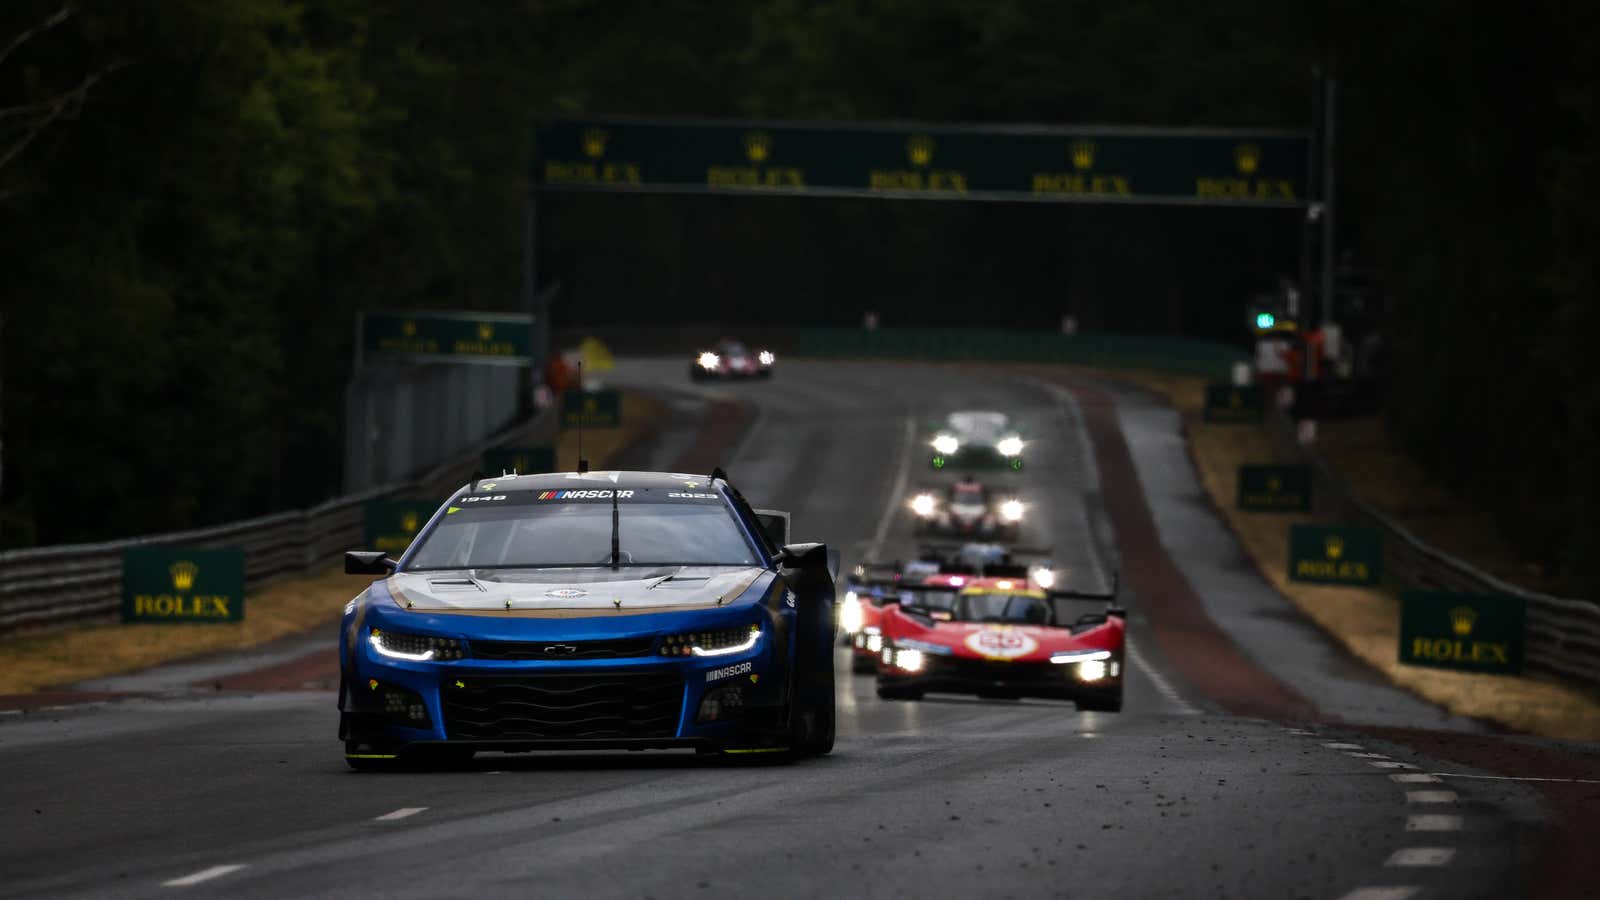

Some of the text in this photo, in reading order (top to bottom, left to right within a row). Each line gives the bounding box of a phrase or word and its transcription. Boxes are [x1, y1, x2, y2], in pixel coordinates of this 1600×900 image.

[545, 161, 641, 184] ROLEX
[707, 165, 805, 190] ROLEX
[870, 170, 968, 193] ROLEX
[1032, 173, 1131, 196] ROLEX
[1196, 176, 1295, 198] ROLEX
[460, 495, 507, 503] 1948
[561, 489, 635, 500] NASCAR
[1296, 560, 1369, 580] ROLEX
[133, 595, 231, 617] ROLEX
[1411, 637, 1509, 663] ROLEX
